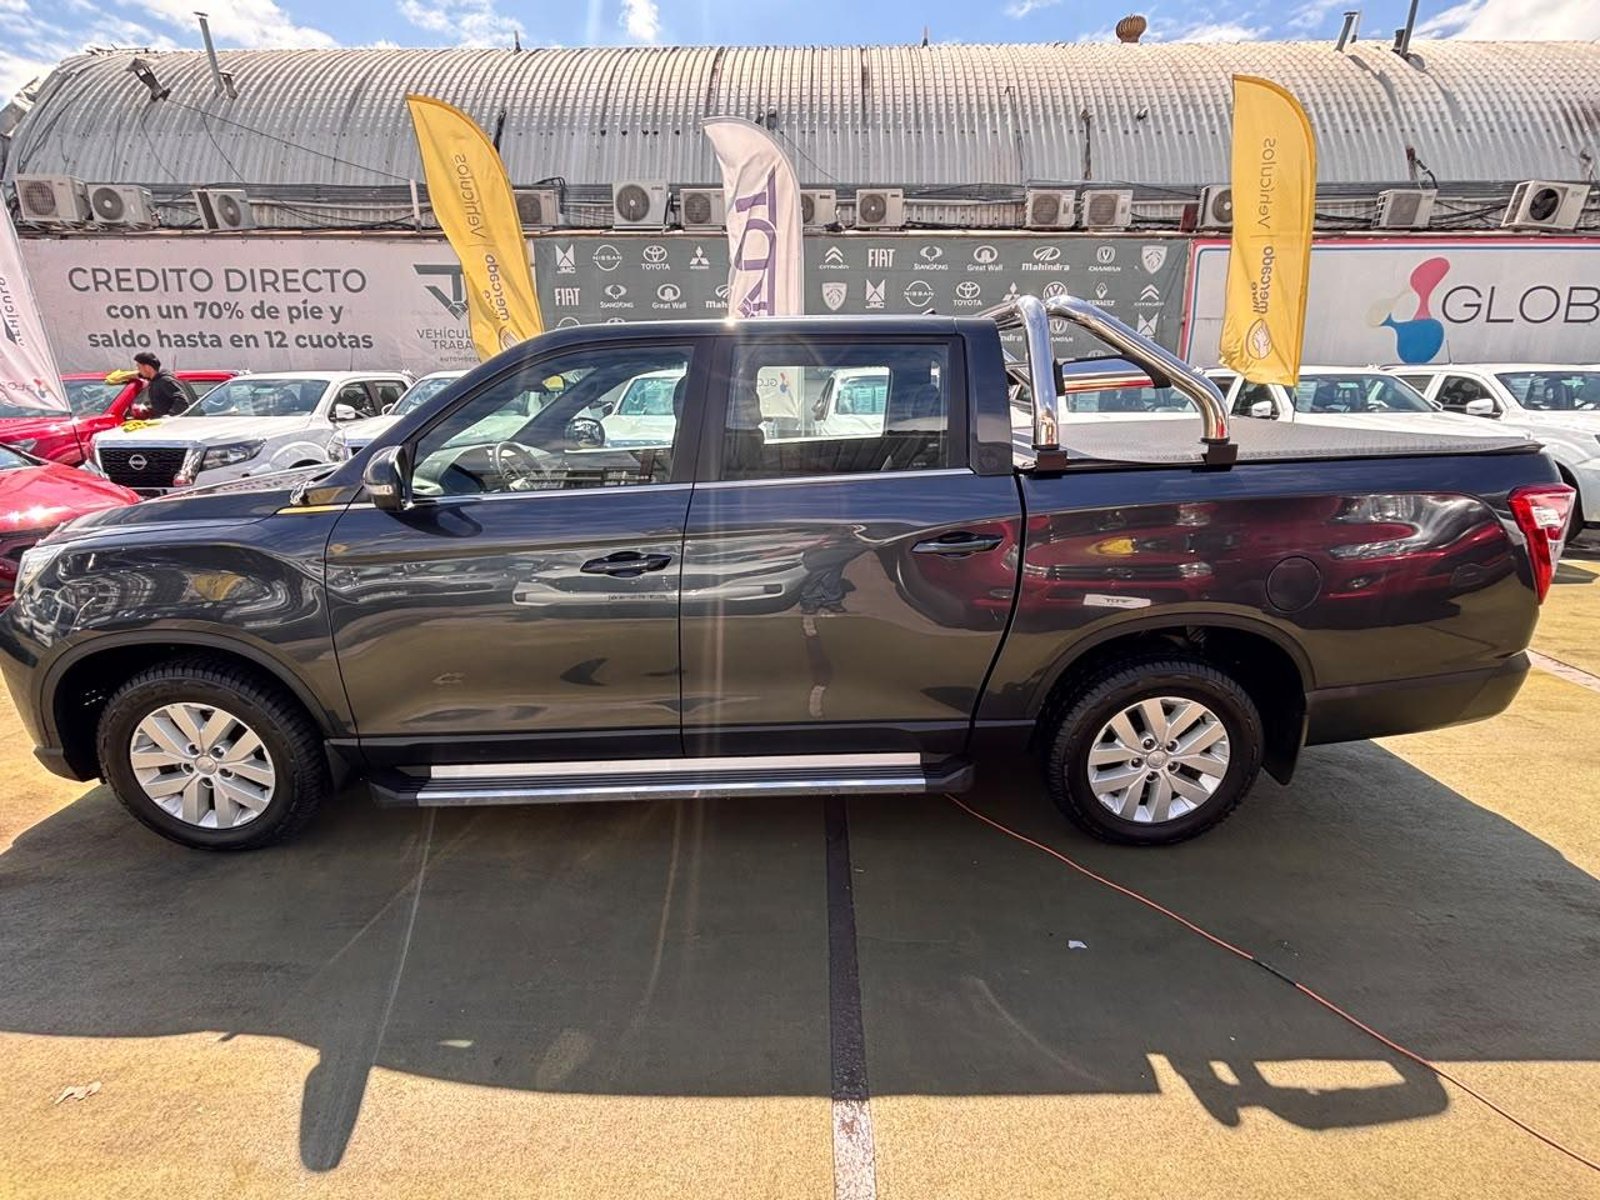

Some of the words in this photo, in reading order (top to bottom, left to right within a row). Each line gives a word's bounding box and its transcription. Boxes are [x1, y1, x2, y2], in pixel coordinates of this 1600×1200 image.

[867, 248, 896, 268] FIAT
[1021, 263, 1071, 271] Mahindra
[68, 267, 214, 292] CREDITO
[224, 268, 367, 293] DIRECTO
[554, 287, 580, 306] FIAT
[651, 301, 671, 309] Great
[1441, 285, 1600, 324] GLOB
[106, 304, 151, 319] con
[157, 304, 188, 319] un
[193, 301, 244, 319] 70%
[250, 300, 280, 319] de
[329, 305, 343, 324] y
[88, 329, 151, 348] saldo
[156, 329, 222, 348] hasta
[229, 333, 259, 348] en
[264, 331, 289, 348] 12
[294, 332, 374, 349] cuotas
